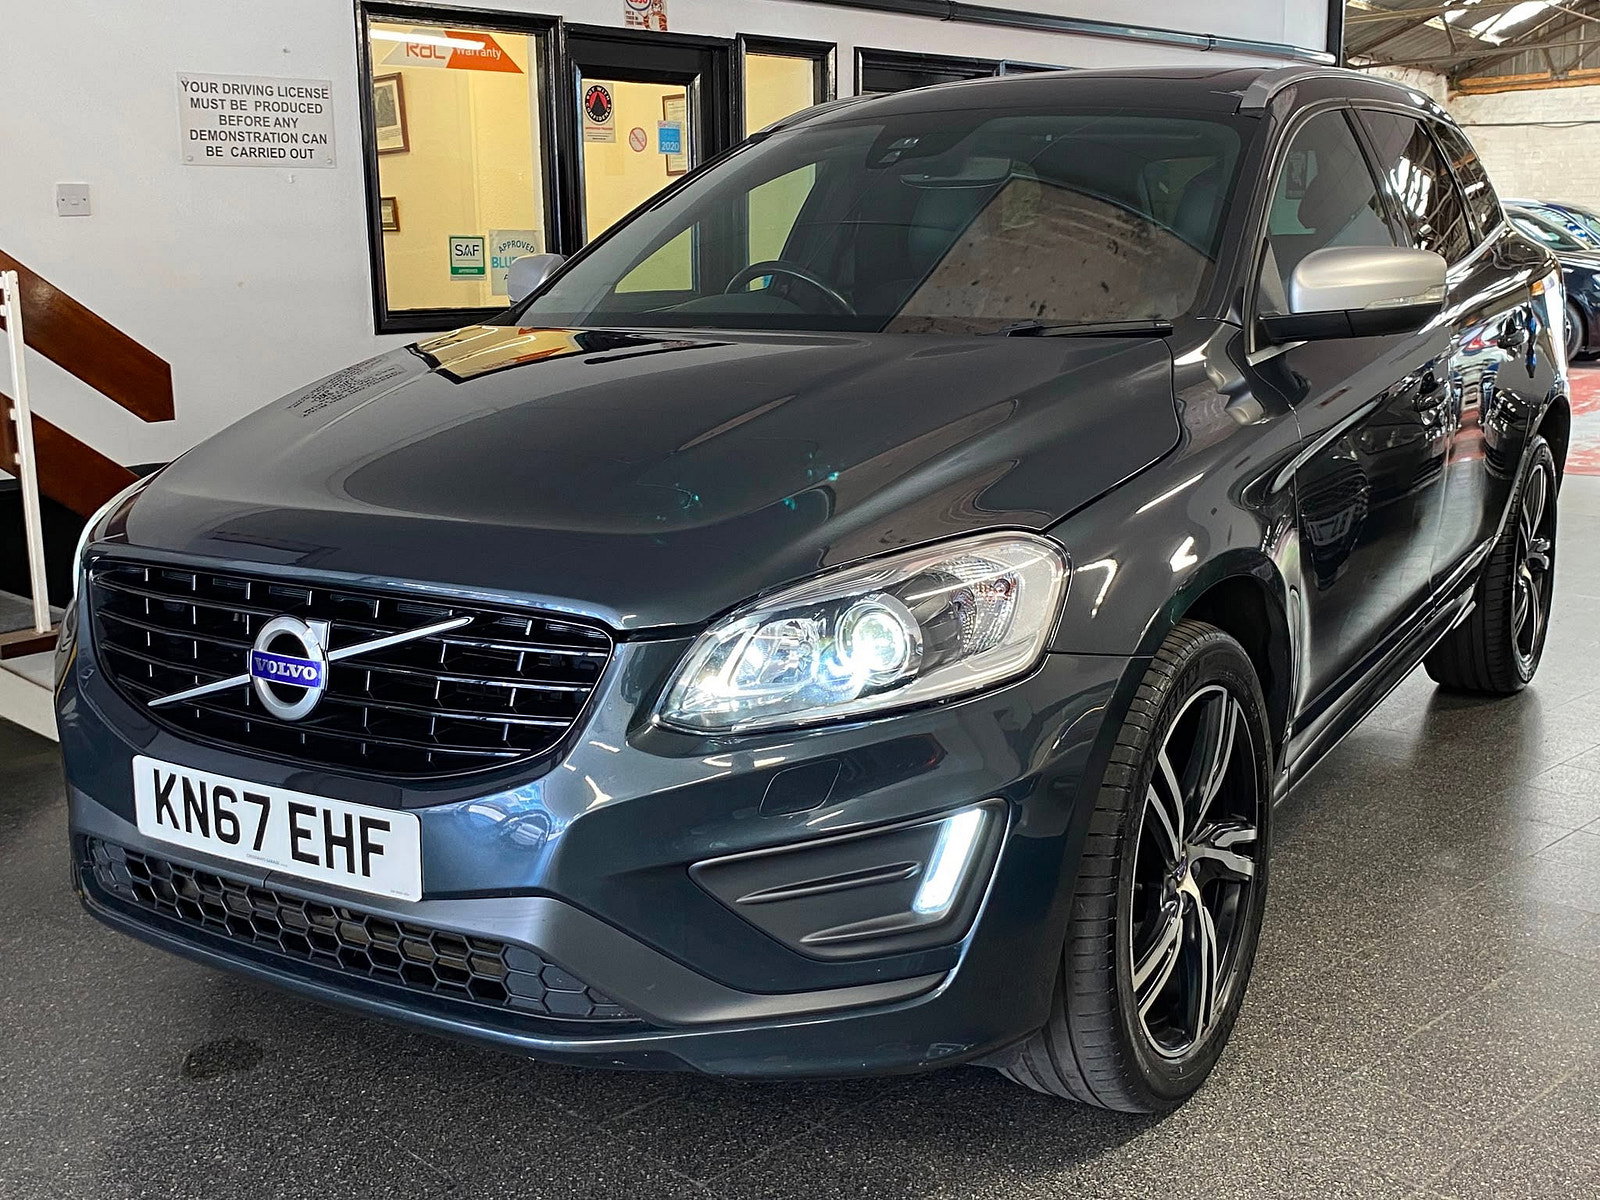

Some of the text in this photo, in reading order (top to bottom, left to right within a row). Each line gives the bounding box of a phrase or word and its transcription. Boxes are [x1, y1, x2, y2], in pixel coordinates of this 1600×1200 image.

[181, 81, 329, 100] YOUR DRIVING LICENSE
[190, 97, 323, 114] MUST BE PRODUCED
[219, 114, 299, 129] BEFORE ANY
[189, 129, 328, 145] DEMONSTRATION CAN
[206, 145, 315, 159] BE CARRIED OUT
[661, 141, 680, 151] 2020
[454, 244, 480, 257] SAF
[498, 240, 535, 254] APPROVED
[491, 256, 518, 269] BLU
[254, 657, 318, 680] VOLVO
[153, 768, 391, 878] KN67 EHF
